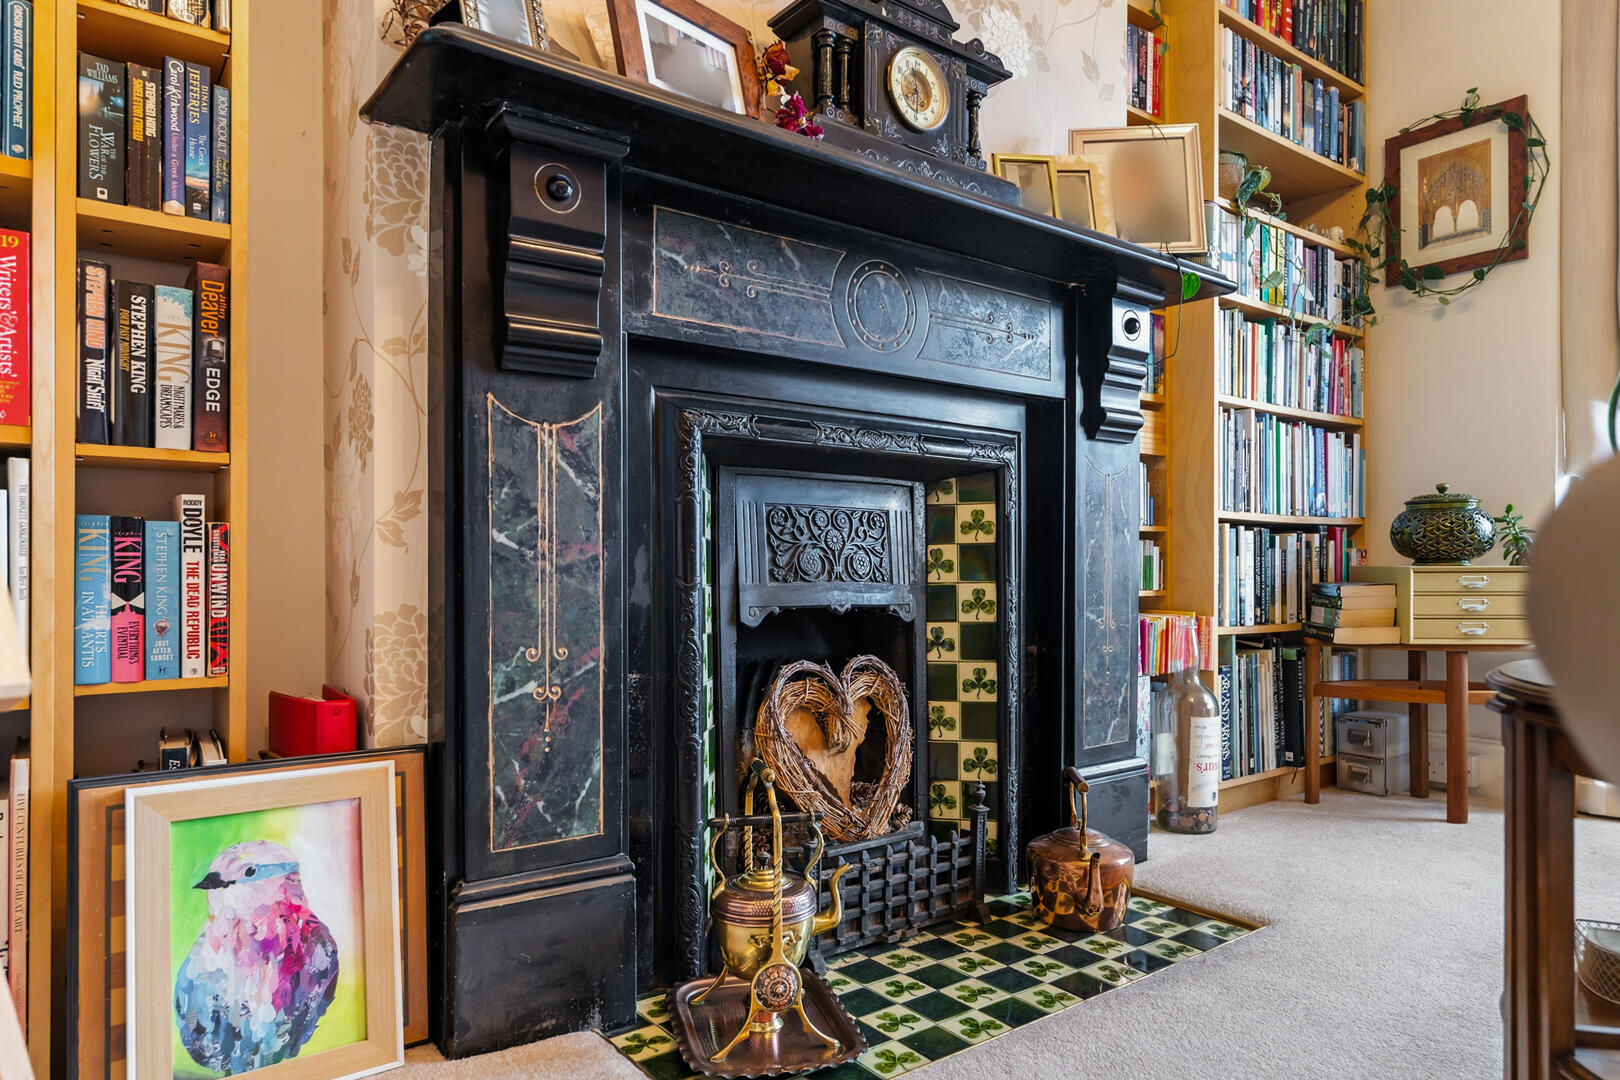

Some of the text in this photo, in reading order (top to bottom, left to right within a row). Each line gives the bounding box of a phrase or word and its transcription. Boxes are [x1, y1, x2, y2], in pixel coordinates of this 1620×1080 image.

[14, 28, 23, 48] SCOTT
[86, 67, 118, 83] WILLIAMS
[96, 62, 109, 72] TAD
[13, 70, 23, 129] RED PROPHET
[133, 78, 143, 141] SKELETON CREW
[145, 81, 156, 137] STEPHEN KING
[165, 60, 184, 132] Carol Kirkwood
[188, 67, 200, 125] JEFFERIES
[201, 85, 209, 113] DINAH
[101, 132, 114, 155] WAR
[171, 133, 179, 152] Under
[189, 137, 197, 159] House
[216, 95, 228, 155] JODI PICOULT
[89, 124, 104, 180] FLOWERS
[101, 155, 106, 163] OF
[171, 160, 179, 178] Greek
[198, 134, 206, 166] The Greek
[85, 266, 105, 349] STEPHEN KING
[200, 279, 225, 337] Deaver
[119, 308, 130, 371] FOUR PAST MIDNIGHT
[130, 294, 146, 394] STEPHEN KING
[158, 322, 191, 384] KING
[160, 384, 172, 429] DREAMSCAPES
[173, 386, 185, 424] NIGHTMARES
[205, 367, 221, 412] EDGE
[183, 507, 202, 553] DOYLE
[78, 528, 109, 582] KING
[114, 537, 142, 583] KING
[156, 532, 168, 615] STEPHEN KING
[82, 591, 94, 606] IN
[186, 561, 200, 659] THE DEAD REPUBLIC
[211, 563, 227, 618] UNWIND
[95, 605, 107, 653] HRTS
[117, 627, 128, 660] EVENTUAL
[128, 621, 140, 665] EVERYTHING'S
[154, 640, 169, 648] JUST
[150, 654, 174, 662] SUNSET
[14, 793, 25, 934] FIVE CENTURIES OF GREAT ART
